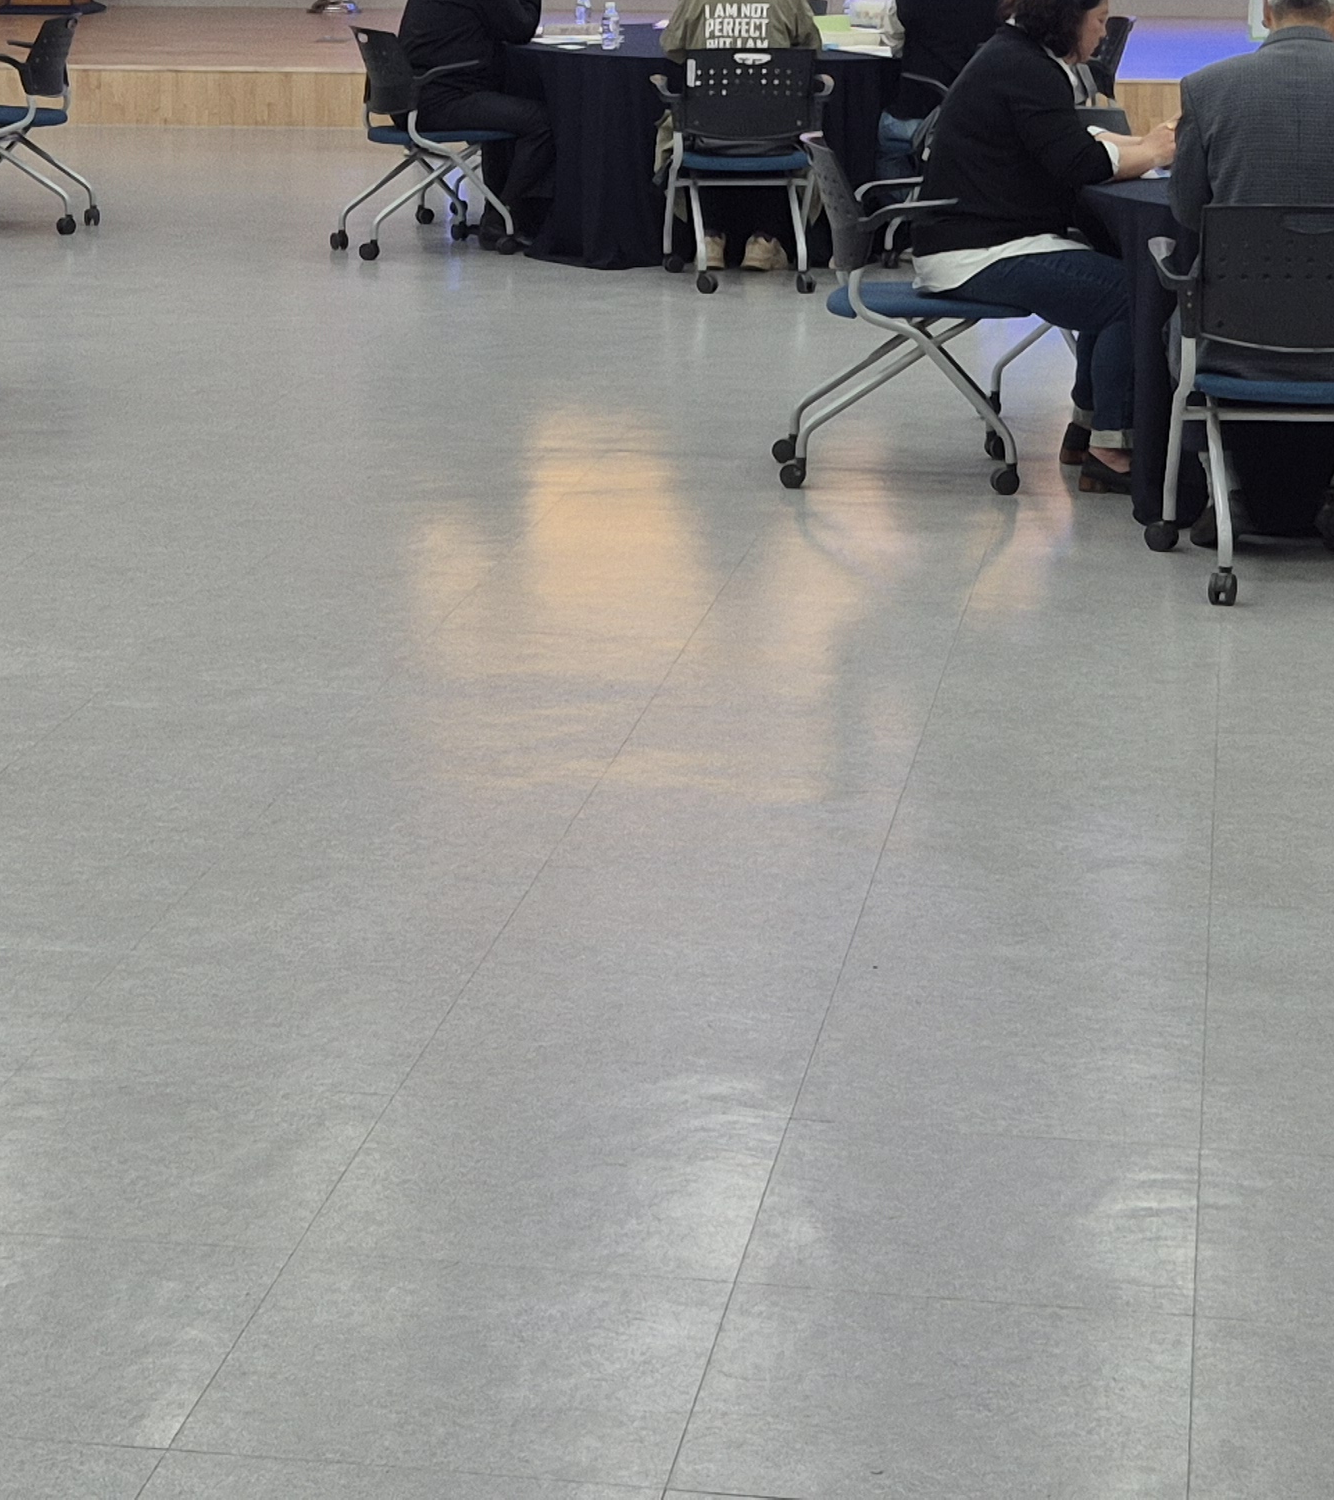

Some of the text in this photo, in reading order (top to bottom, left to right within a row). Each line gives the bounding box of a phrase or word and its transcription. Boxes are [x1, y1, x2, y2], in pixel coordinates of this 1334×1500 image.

[704, 2, 770, 20] I AM NOT
[704, 18, 769, 39] PERFECT
[746, 37, 769, 49] AM
